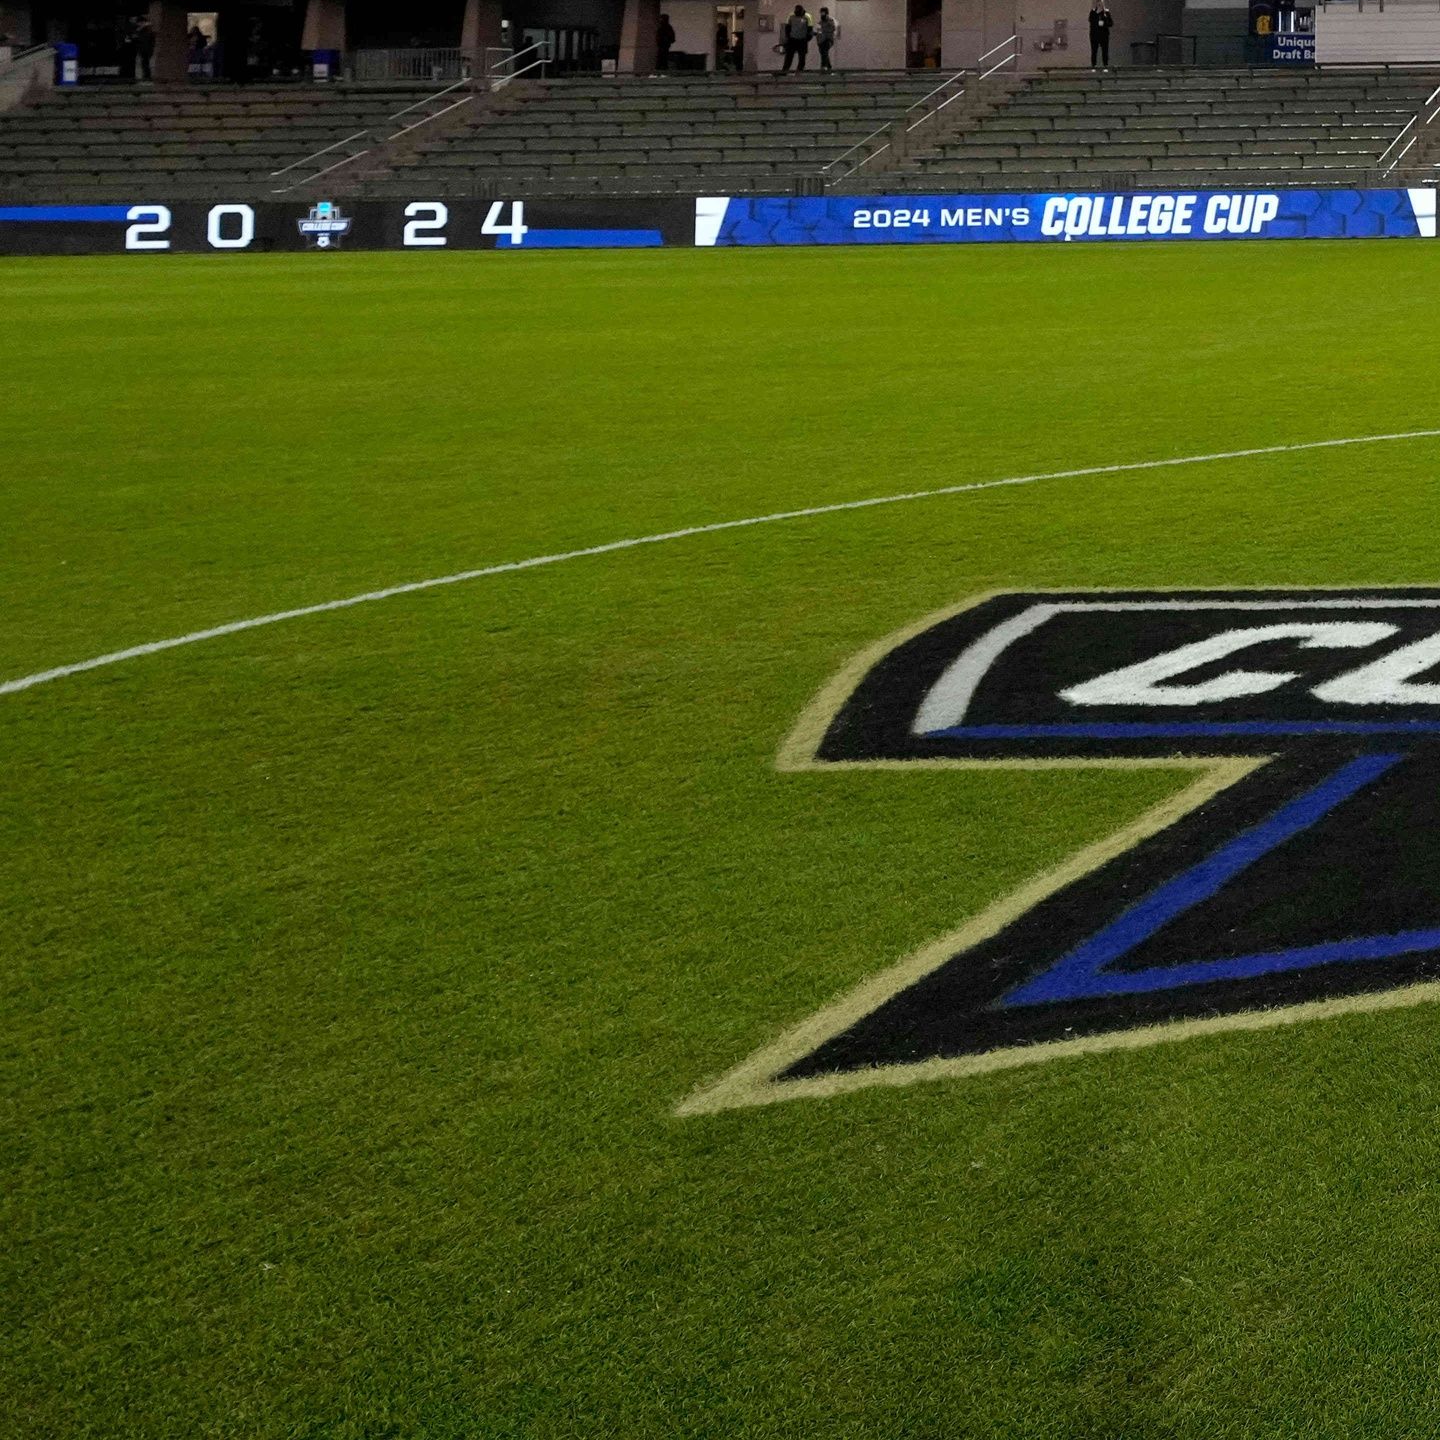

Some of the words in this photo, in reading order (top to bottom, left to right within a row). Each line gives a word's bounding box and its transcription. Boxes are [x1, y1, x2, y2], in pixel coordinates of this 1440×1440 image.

[1272, 50, 1301, 59] Draft
[853, 209, 930, 228] 2024
[1041, 195, 1193, 236] COLLEGE
[1203, 194, 1279, 234] CUP
